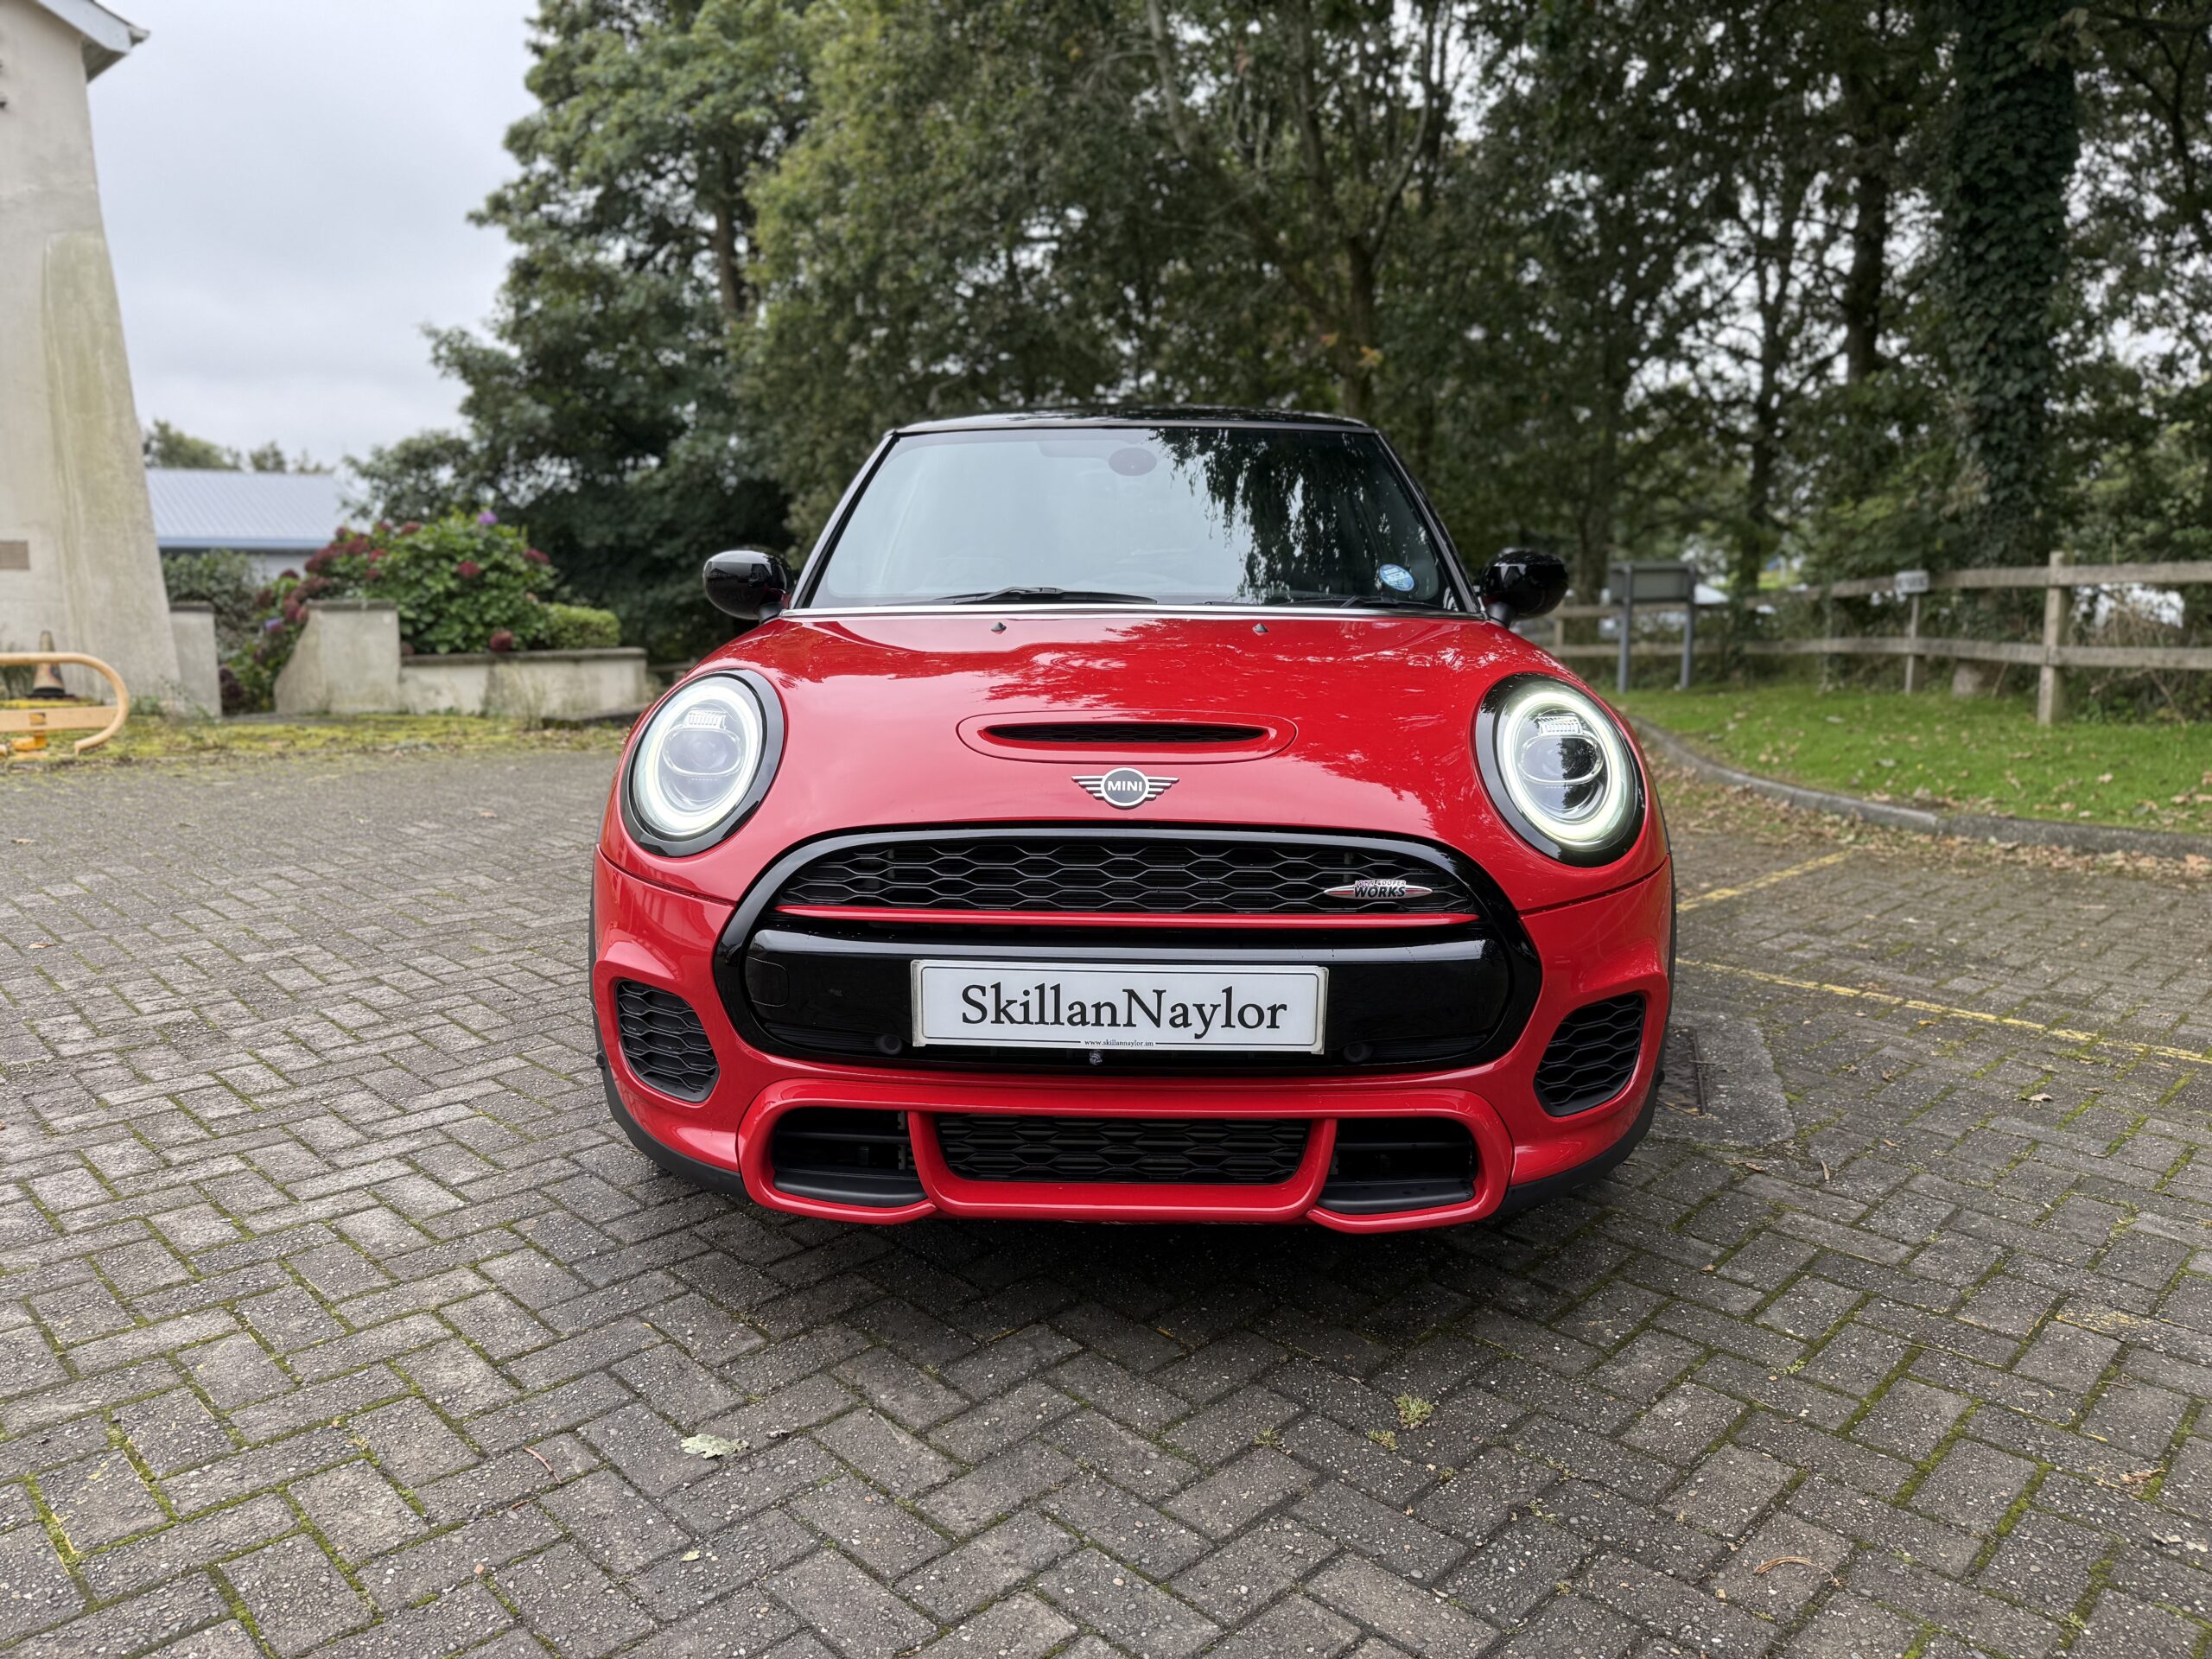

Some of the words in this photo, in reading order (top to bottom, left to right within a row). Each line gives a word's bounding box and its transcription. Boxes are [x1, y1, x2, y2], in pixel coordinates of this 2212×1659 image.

[1107, 781, 1143, 792] MINI
[1354, 887, 1406, 898] WORKS
[961, 982, 1287, 1039] SkillanNaylor
[1084, 1039, 1154, 1047] www.skillannaylor.im
